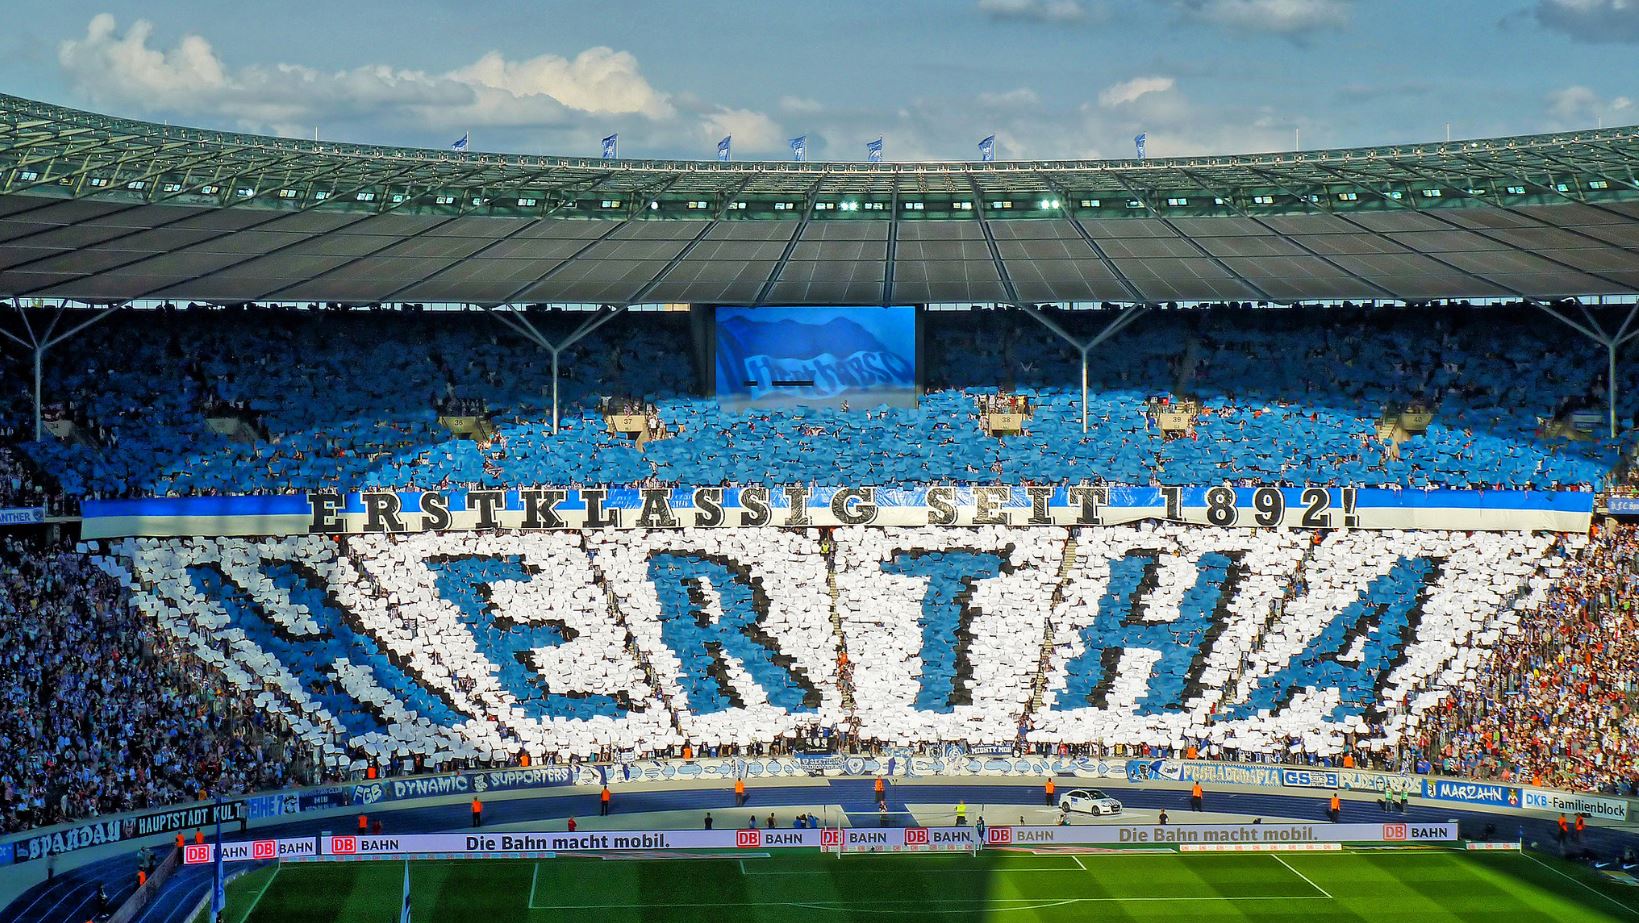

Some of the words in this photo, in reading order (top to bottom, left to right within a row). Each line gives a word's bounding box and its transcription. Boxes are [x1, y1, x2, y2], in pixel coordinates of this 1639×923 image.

[307, 487, 878, 533] ERSTKLASSIG
[926, 486, 1109, 525] SEIT
[1159, 486, 1359, 527] 1892!
[187, 546, 1445, 737] HERTHA
[971, 746, 997, 754] MIGHTY
[394, 775, 467, 798] DYNAMIC
[490, 768, 568, 786] SUPPORTERS
[1441, 783, 1502, 801] MARZAHN
[139, 808, 208, 835] HAUPTSTADT
[213, 802, 241, 822] KULT
[29, 820, 120, 859] SPANDAU
[738, 831, 758, 844] DB
[765, 833, 802, 844] BAHN
[849, 832, 887, 843] BAHN
[906, 830, 926, 843] DB
[934, 831, 970, 842] BAHN
[990, 829, 1010, 842] DB
[1017, 830, 1054, 841] BAHN
[1119, 828, 1148, 842] Die
[1153, 828, 1198, 842] Bahn
[1203, 827, 1258, 841] macht
[1263, 825, 1318, 840] mobil.
[1384, 825, 1405, 839] DB
[1411, 827, 1447, 838] BAHN
[254, 841, 273, 856] DB
[280, 841, 313, 854] BAHN
[333, 838, 354, 852] DB
[361, 839, 399, 851] BAHN
[466, 835, 495, 850] Die
[502, 835, 547, 850] Bahn
[553, 834, 609, 849] macht
[614, 833, 670, 848] mobil.
[188, 846, 208, 861] DB
